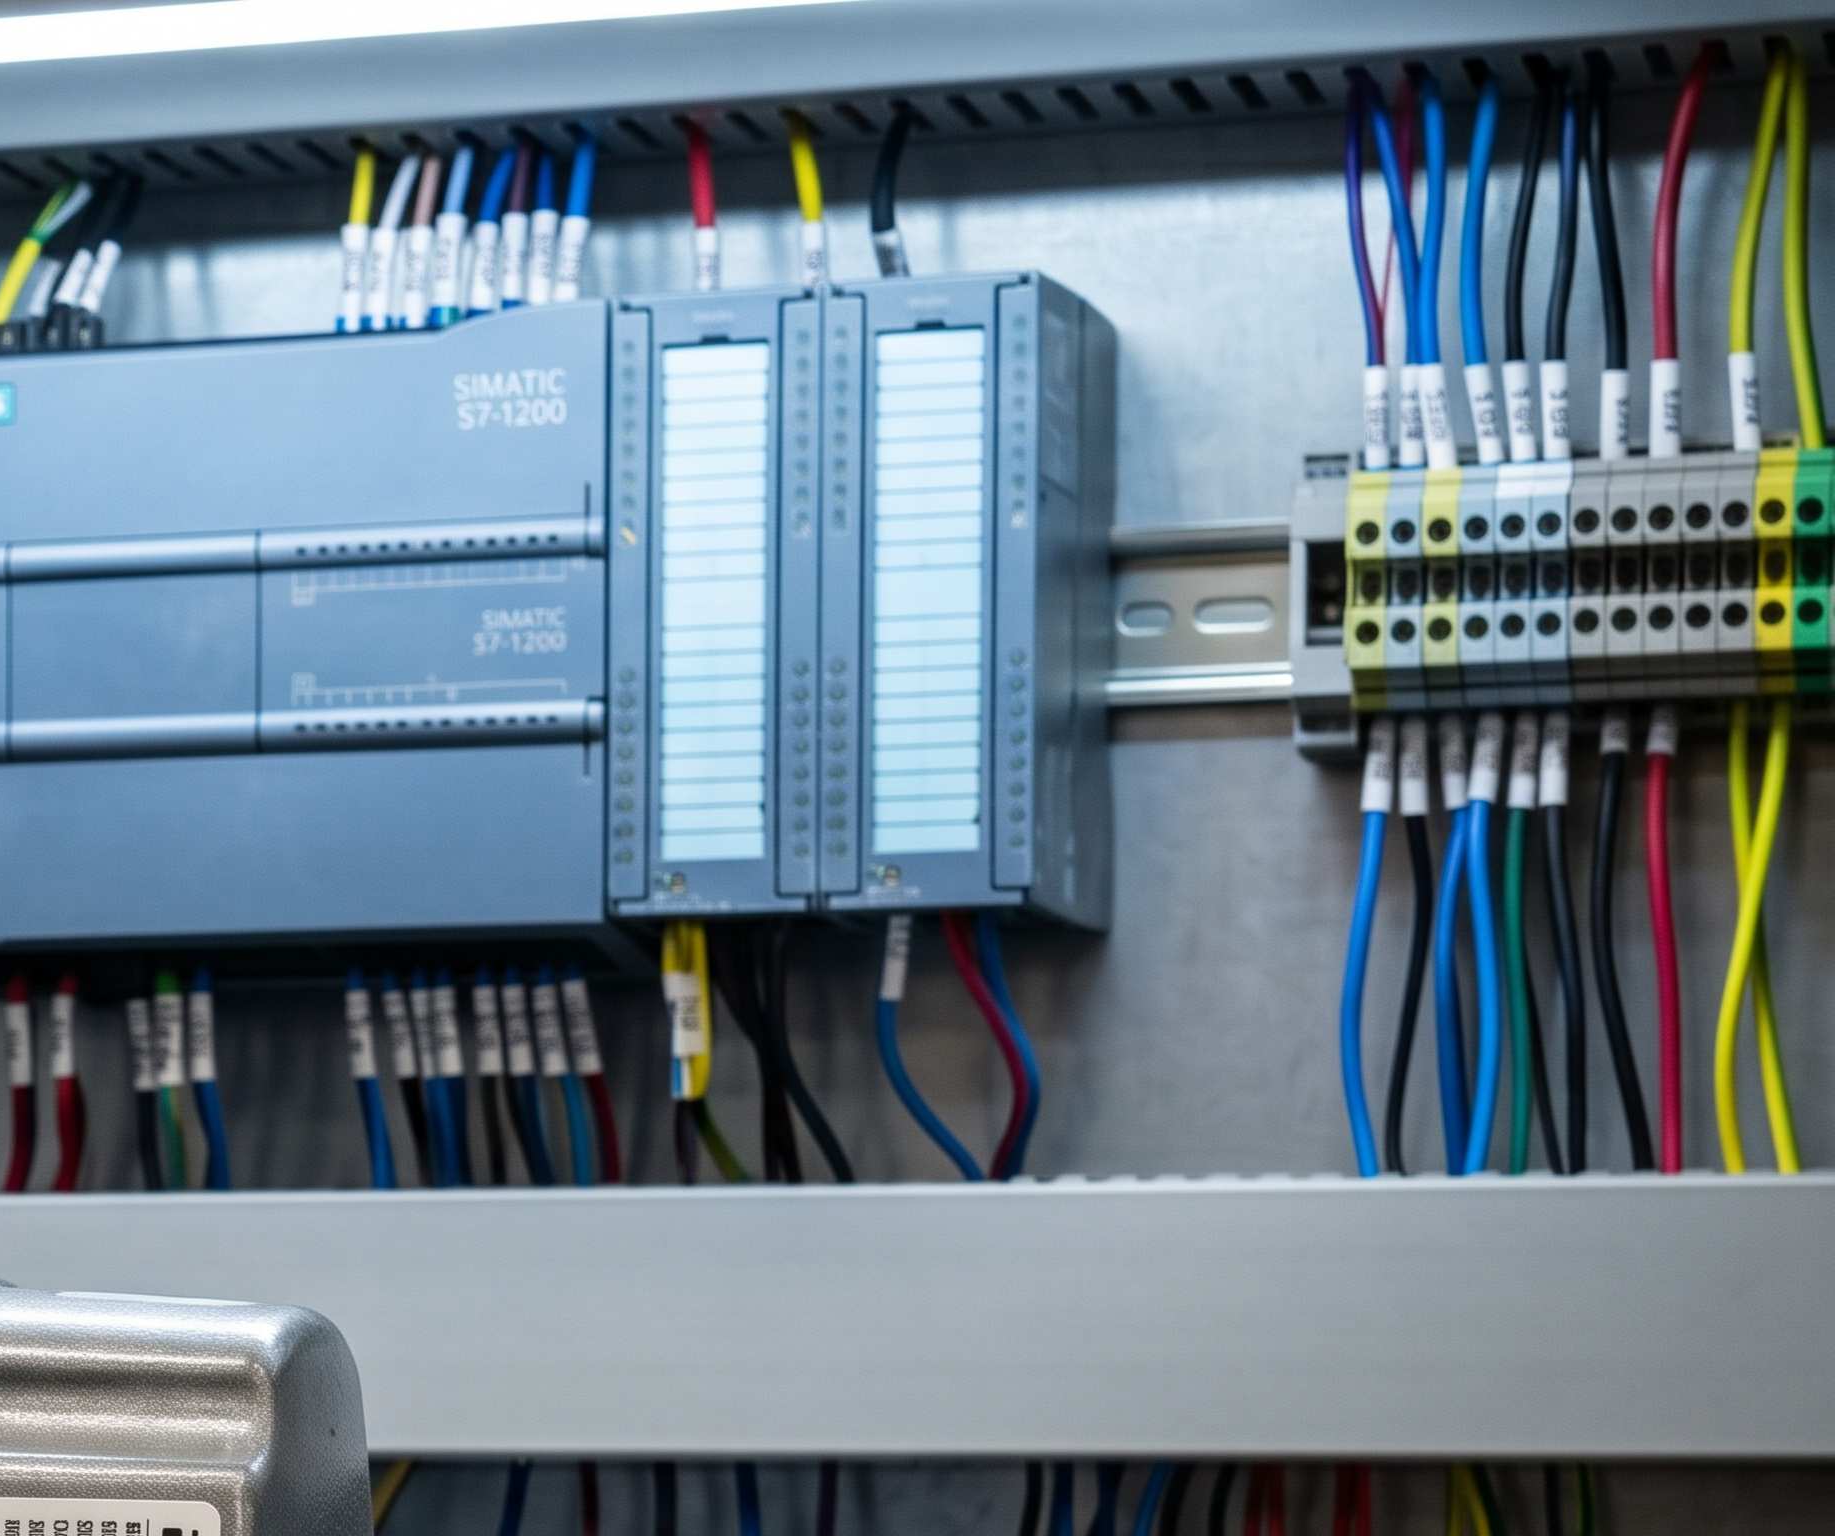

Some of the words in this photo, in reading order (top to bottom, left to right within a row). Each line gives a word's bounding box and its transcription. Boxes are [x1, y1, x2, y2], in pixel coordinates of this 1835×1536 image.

[453, 368, 567, 401] SIMATIC
[456, 398, 568, 430] S7-1200
[480, 607, 567, 631] SIMATIC
[472, 630, 568, 655] S7-1200
